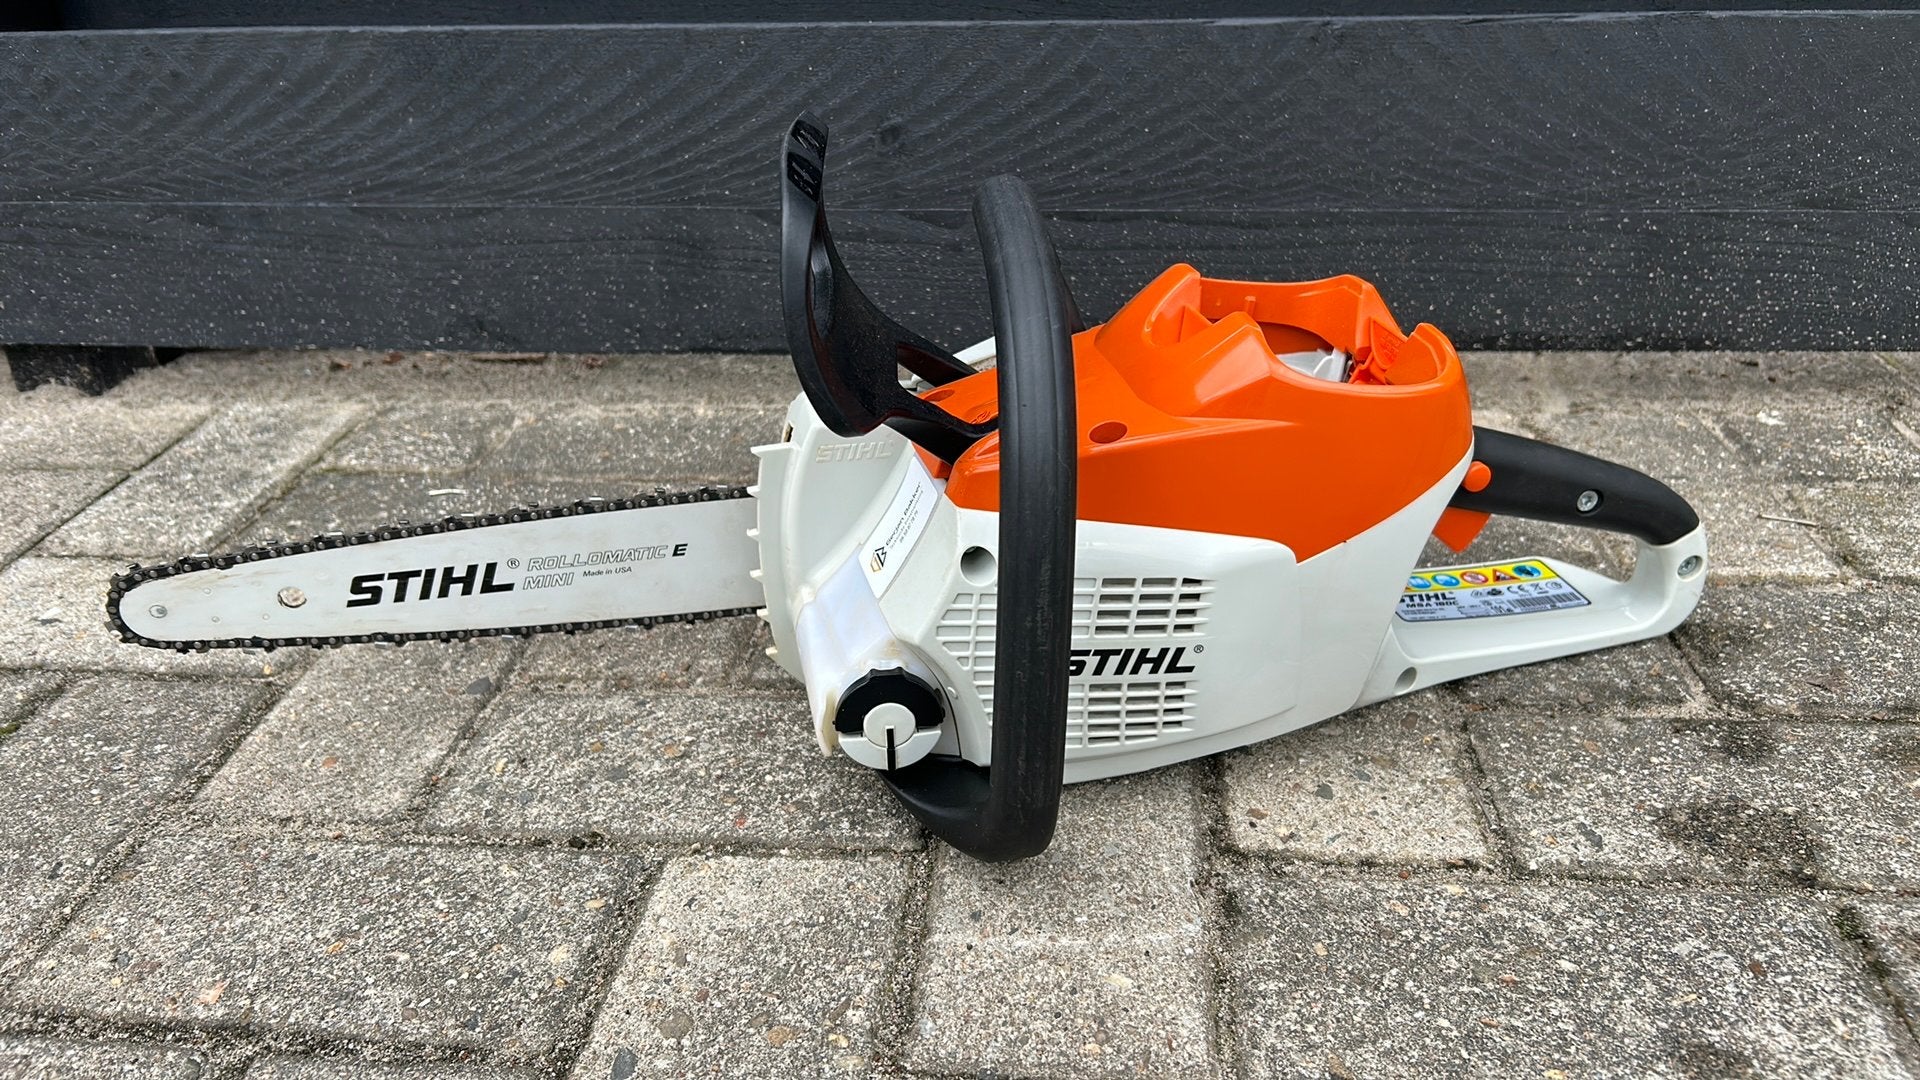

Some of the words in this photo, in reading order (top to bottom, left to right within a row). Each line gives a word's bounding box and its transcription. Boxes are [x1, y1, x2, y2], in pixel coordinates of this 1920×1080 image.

[815, 442, 892, 463] STIHL
[527, 545, 668, 572] ROLLOMATIC
[672, 543, 688, 557] E
[523, 572, 575, 591] MINI
[582, 568, 604, 578] Made
[605, 568, 612, 576] in
[614, 566, 632, 575] USA
[346, 562, 515, 608] STIHL
[1069, 647, 1195, 676] STIHL
